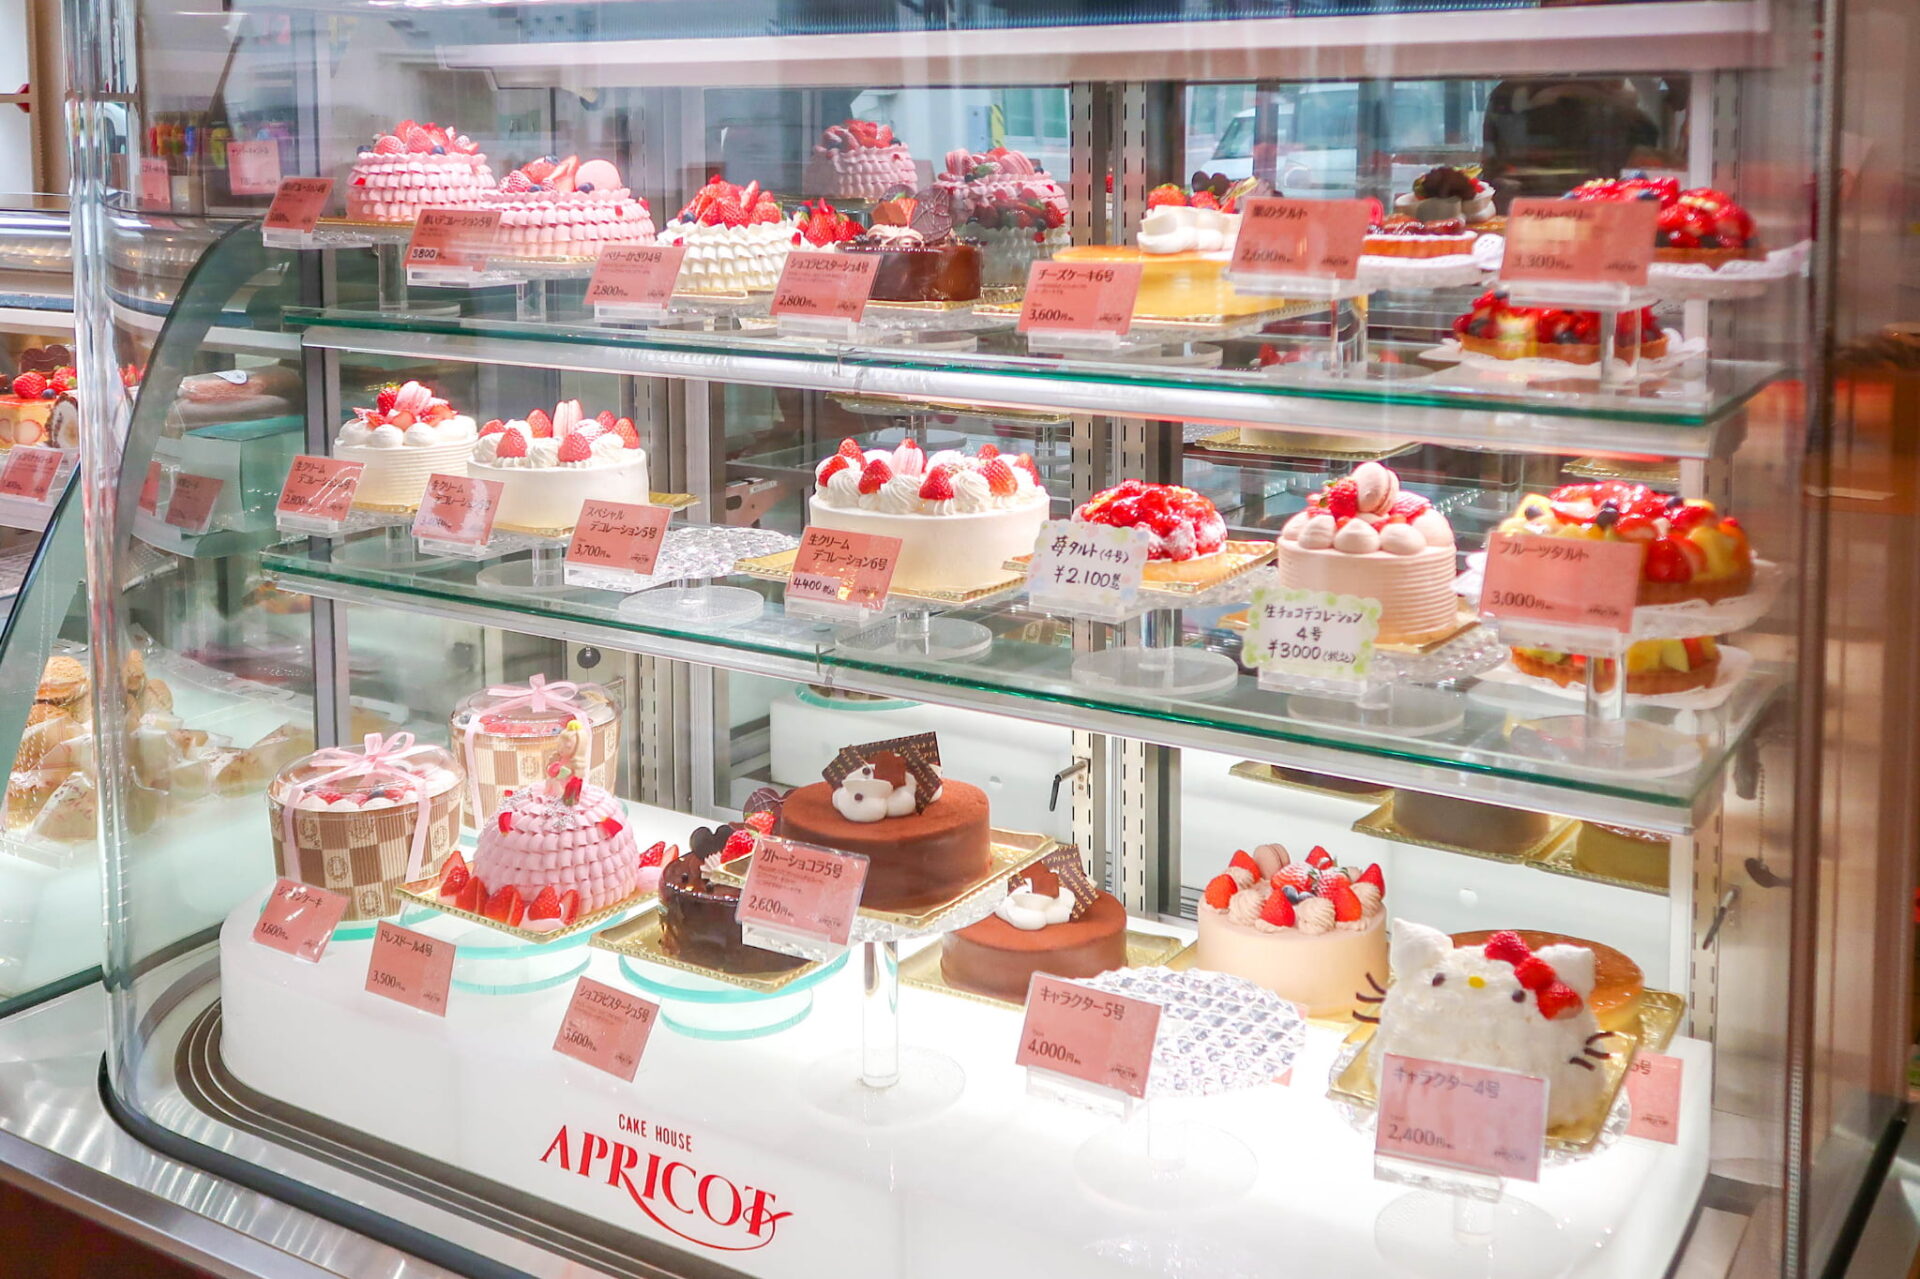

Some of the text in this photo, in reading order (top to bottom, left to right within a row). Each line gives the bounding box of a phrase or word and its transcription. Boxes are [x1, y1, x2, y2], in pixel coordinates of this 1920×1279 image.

[1038, 268, 1115, 283] チーズケーキ6号
[586, 506, 625, 521] スペシャル
[589, 520, 658, 540] デコレーション5号
[807, 533, 850, 551] 生クリーム
[812, 549, 889, 572] デコレーション6号
[1264, 603, 1364, 624] 生チョコデコレーション
[1296, 626, 1323, 642] 4号
[761, 848, 843, 879] ガトーショコラ5号
[1041, 985, 1126, 1021] キャラクター5号
[1028, 1038, 1074, 1063] 4,000円
[1394, 1066, 1500, 1099] キャラクター4号
[618, 1113, 693, 1153] CAKE HOUSE
[539, 1124, 794, 1251] APRICOT
